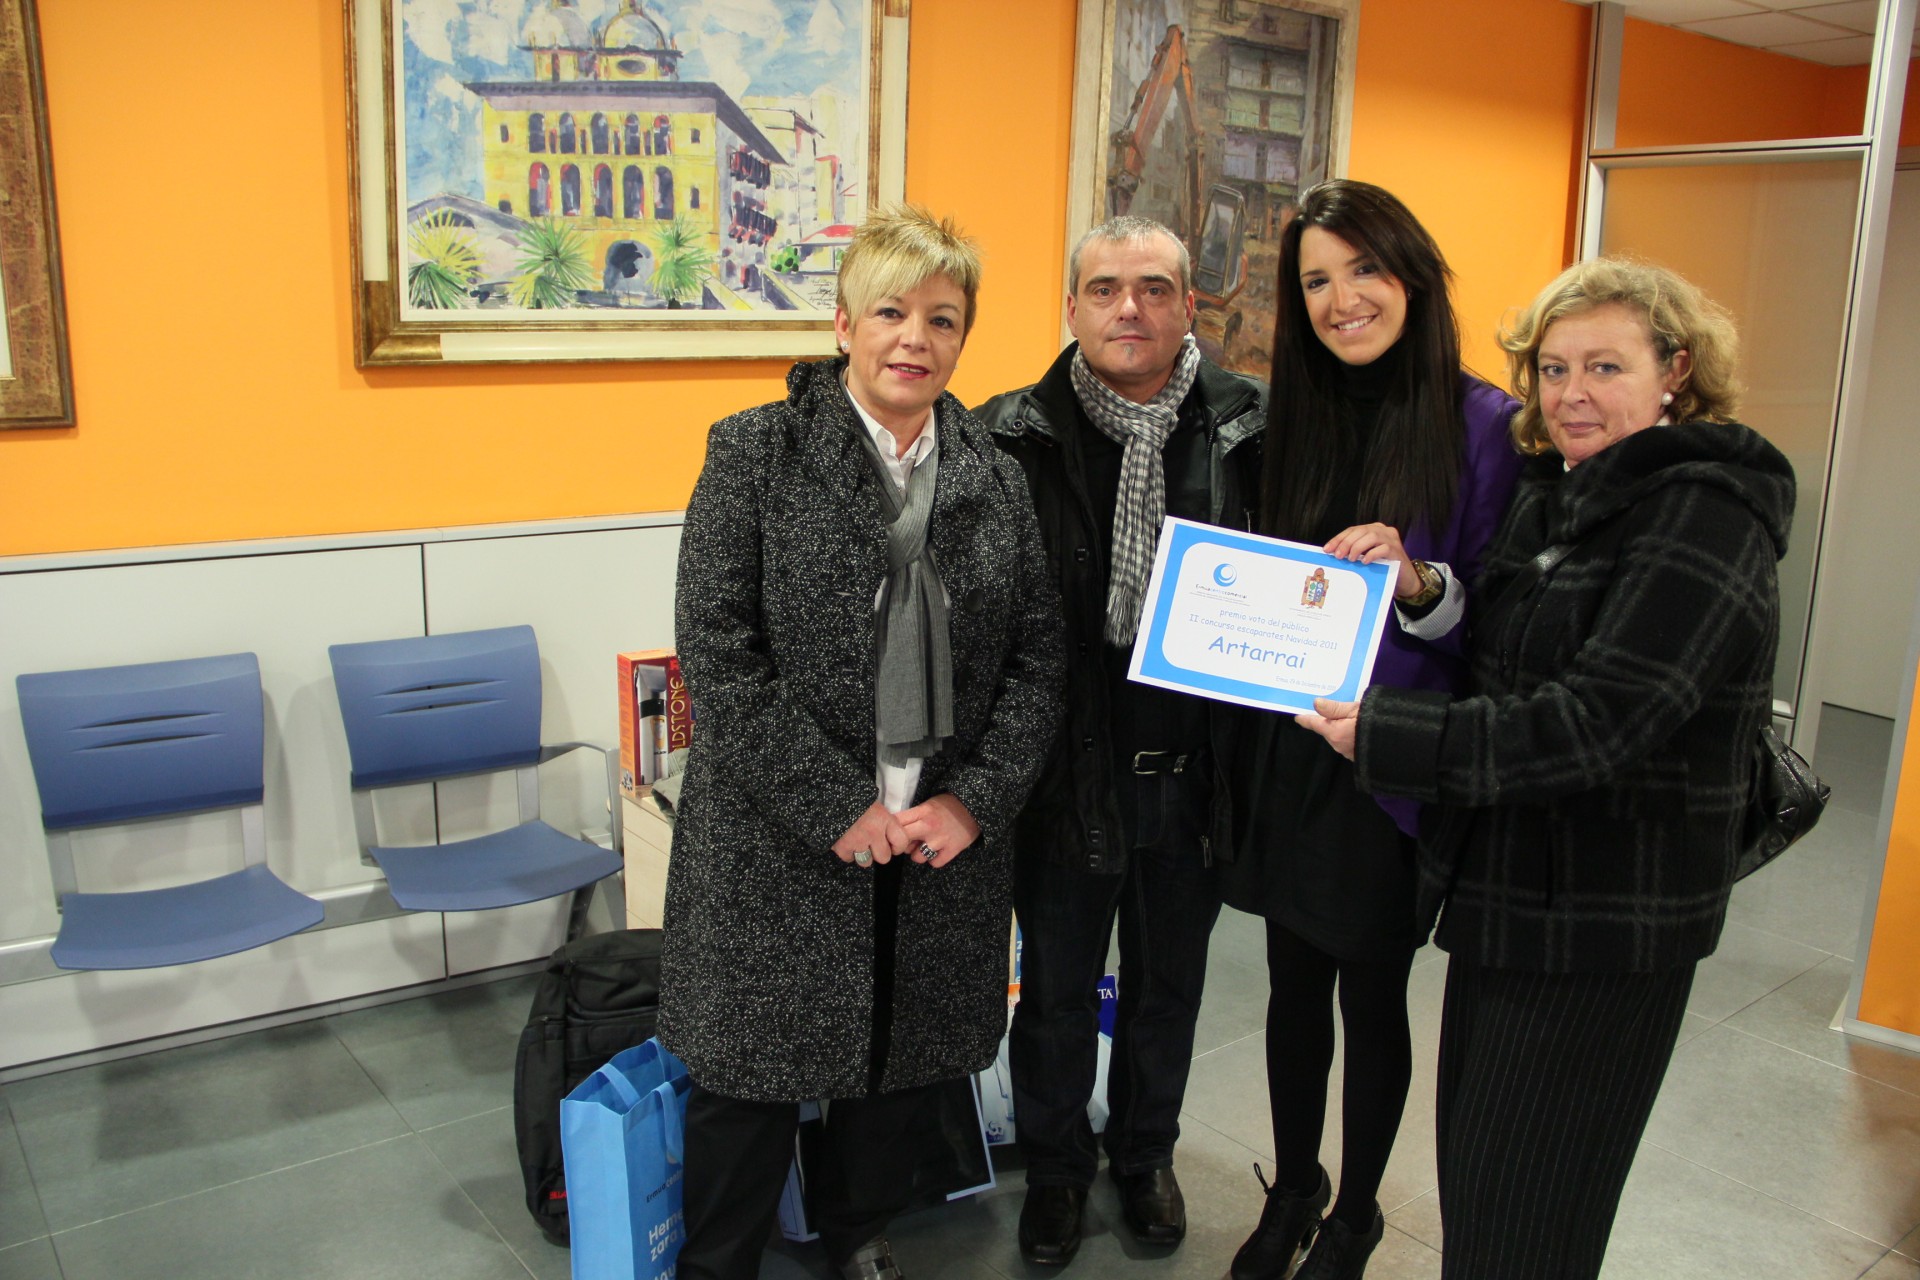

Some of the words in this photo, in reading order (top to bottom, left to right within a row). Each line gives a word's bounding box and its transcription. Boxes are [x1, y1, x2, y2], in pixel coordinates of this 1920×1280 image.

[1188, 613, 1199, 623] II
[1200, 617, 1235, 631] concurso
[1236, 625, 1284, 641] escaparates
[1285, 633, 1318, 647] Navidad
[1319, 639, 1338, 650] 2011
[1219, 608, 1247, 621] premio
[1248, 614, 1266, 624] voto
[1268, 616, 1281, 627] del
[1281, 620, 1310, 633] público
[1208, 635, 1307, 669] Artarrai
[670, 676, 687, 752] LDSTONE
[1096, 988, 1114, 1000] TA
[648, 1207, 684, 1246] Heme
